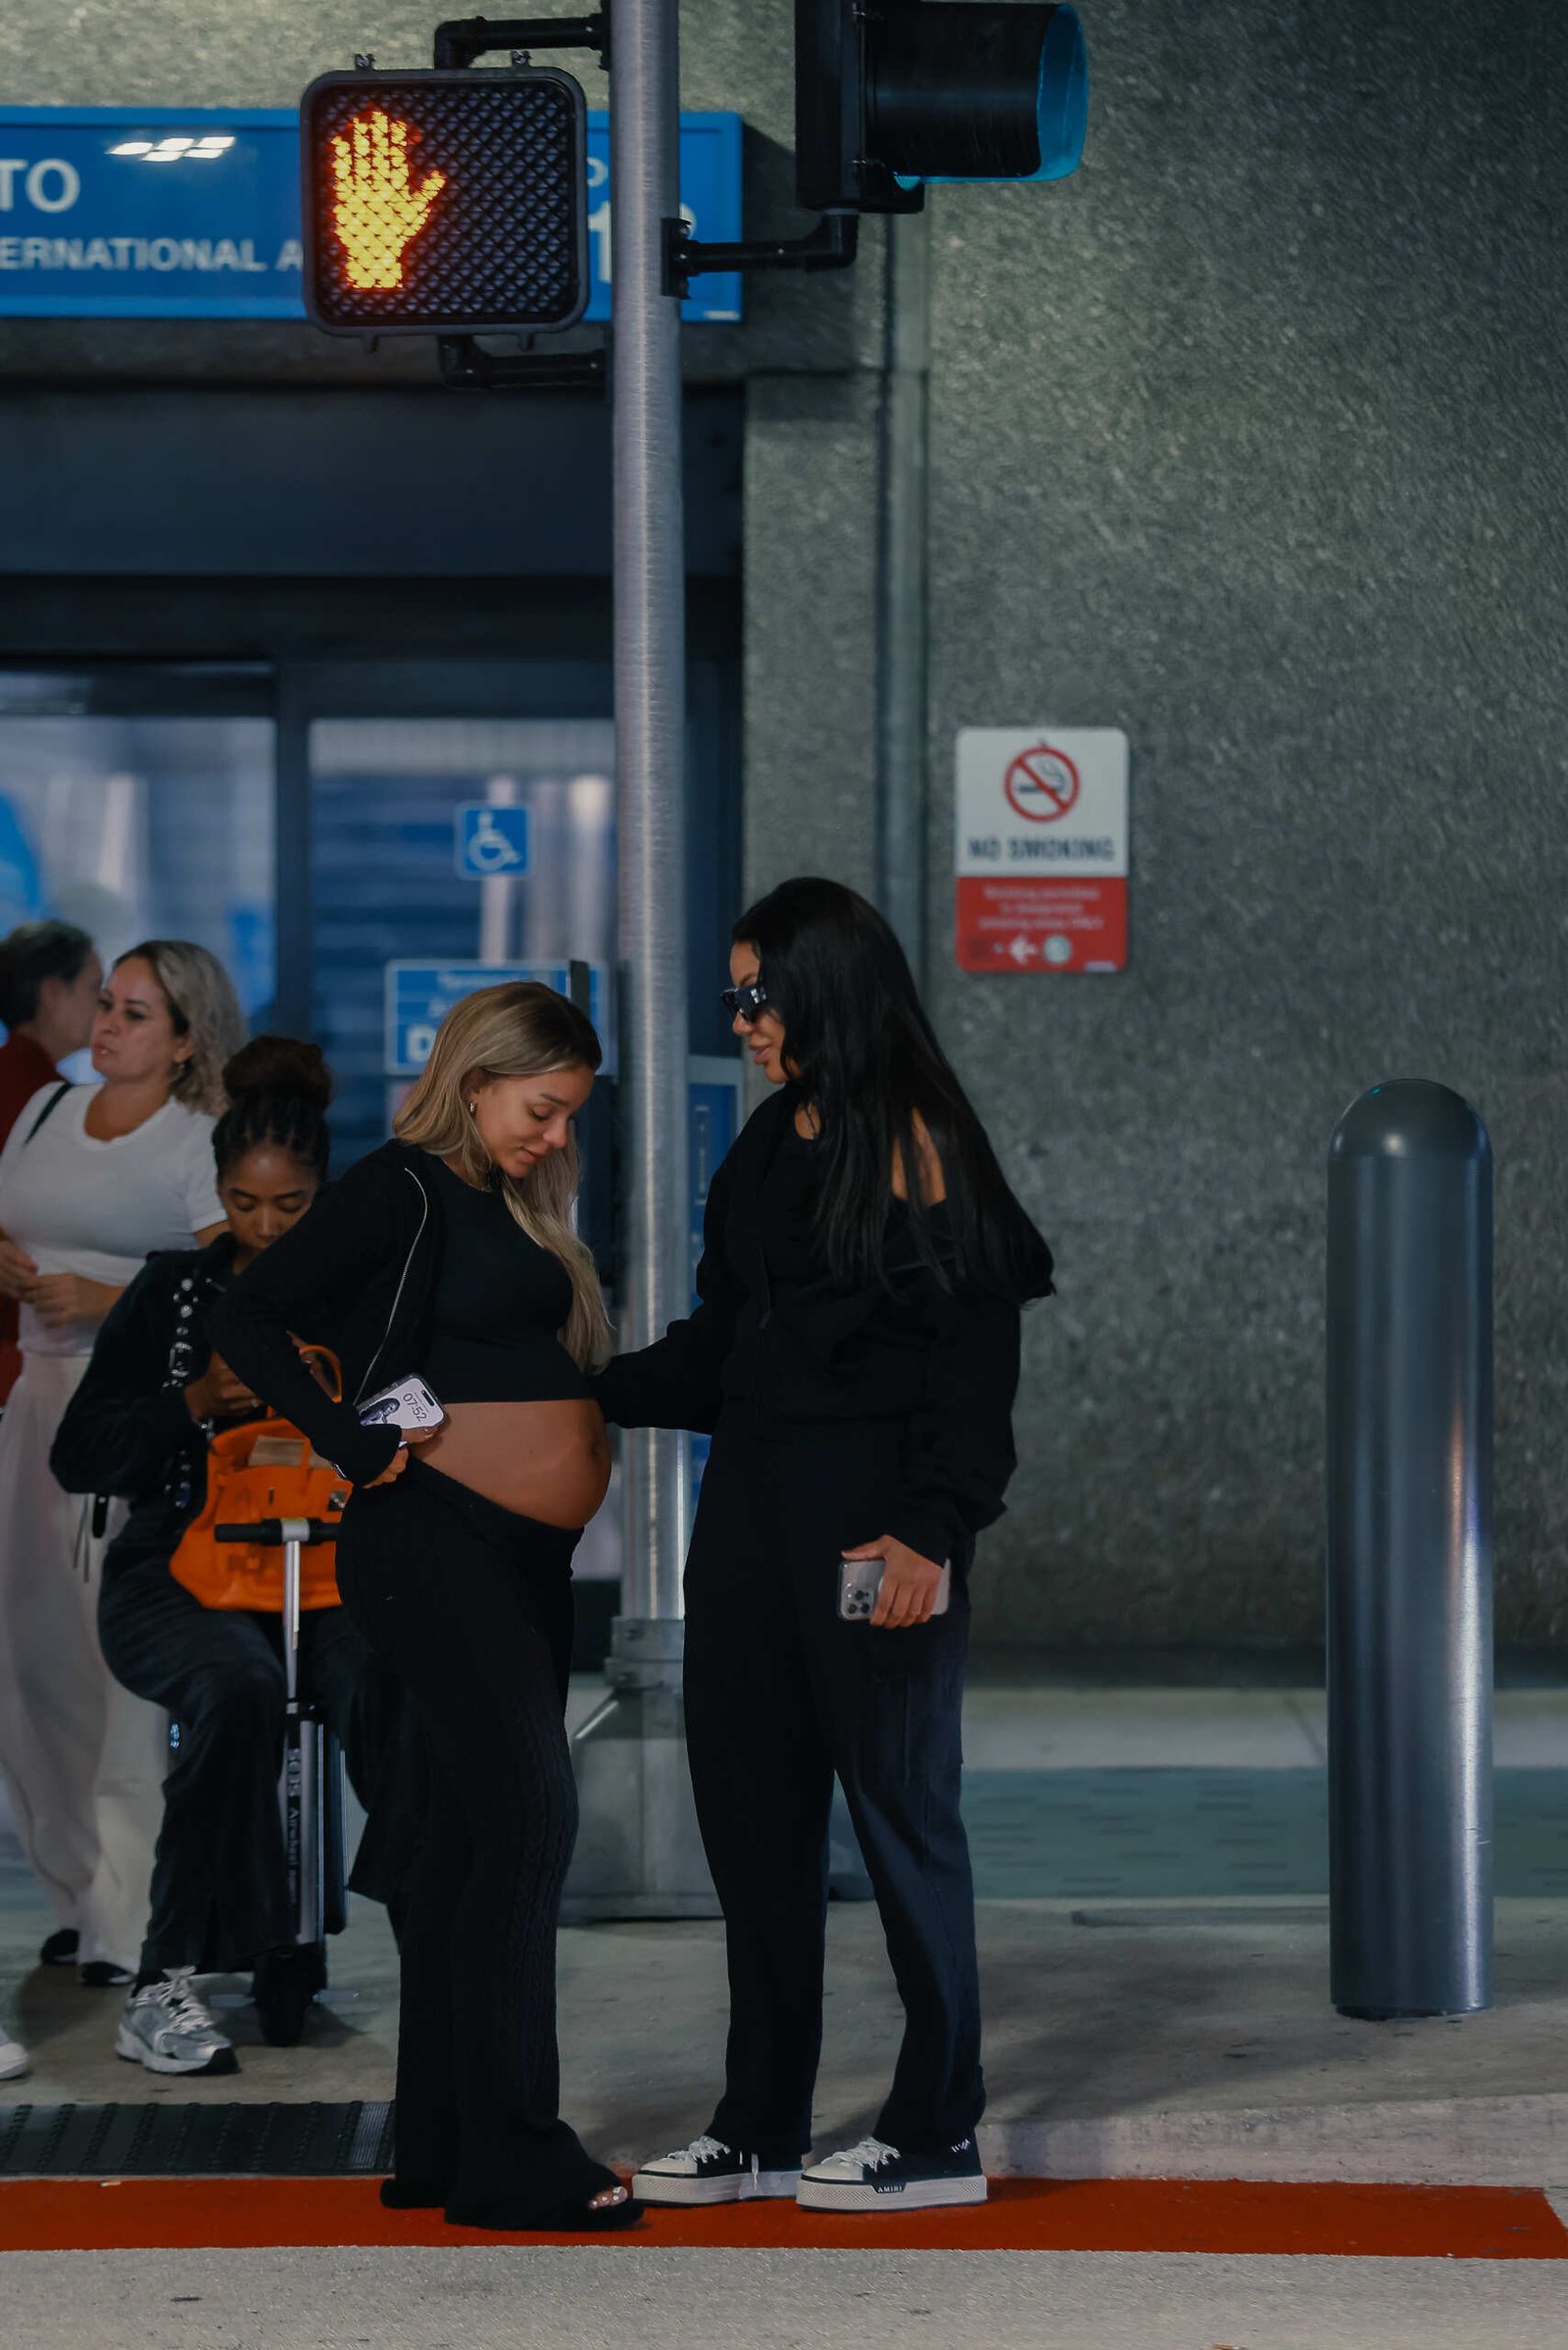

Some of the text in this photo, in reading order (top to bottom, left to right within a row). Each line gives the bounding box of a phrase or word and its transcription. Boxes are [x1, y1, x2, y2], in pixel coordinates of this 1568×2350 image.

[967, 836, 1115, 861] NO SMOKING
[403, 1393, 427, 1422] 07:52
